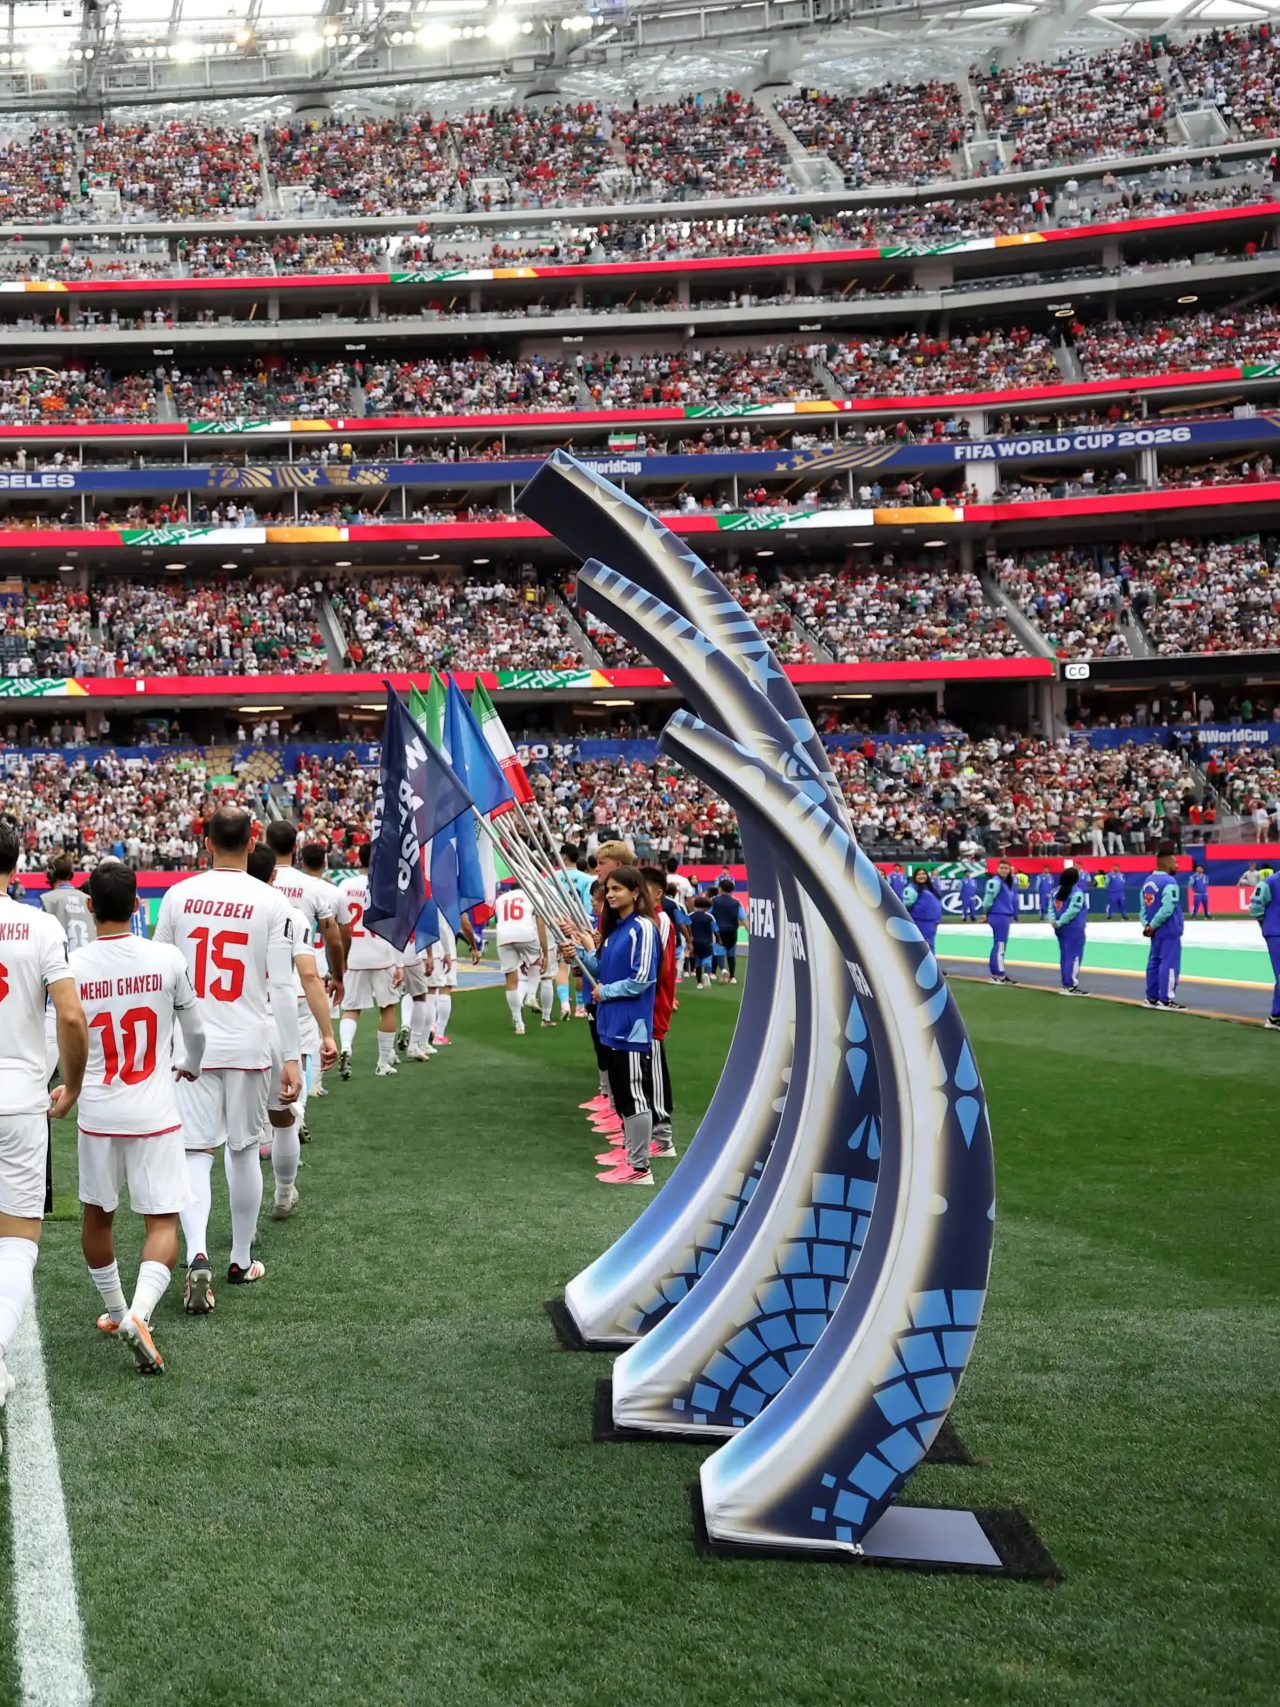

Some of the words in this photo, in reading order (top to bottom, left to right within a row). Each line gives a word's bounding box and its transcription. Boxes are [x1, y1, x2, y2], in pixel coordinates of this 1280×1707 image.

[954, 444, 996, 460] FIFA
[998, 437, 1070, 457] WORLD
[1073, 433, 1115, 450] CUP
[1118, 426, 1192, 446] 2026
[582, 460, 642, 475] WorldCup
[1068, 666, 1087, 677] CC
[183, 898, 254, 920] ROOZBEH
[503, 897, 524, 922] 16
[749, 897, 776, 939] FIFA
[186, 926, 249, 1003] 15
[80, 979, 113, 1001] MEHDI
[117, 973, 163, 996] GHAYEDI
[88, 1006, 158, 1086] 10
